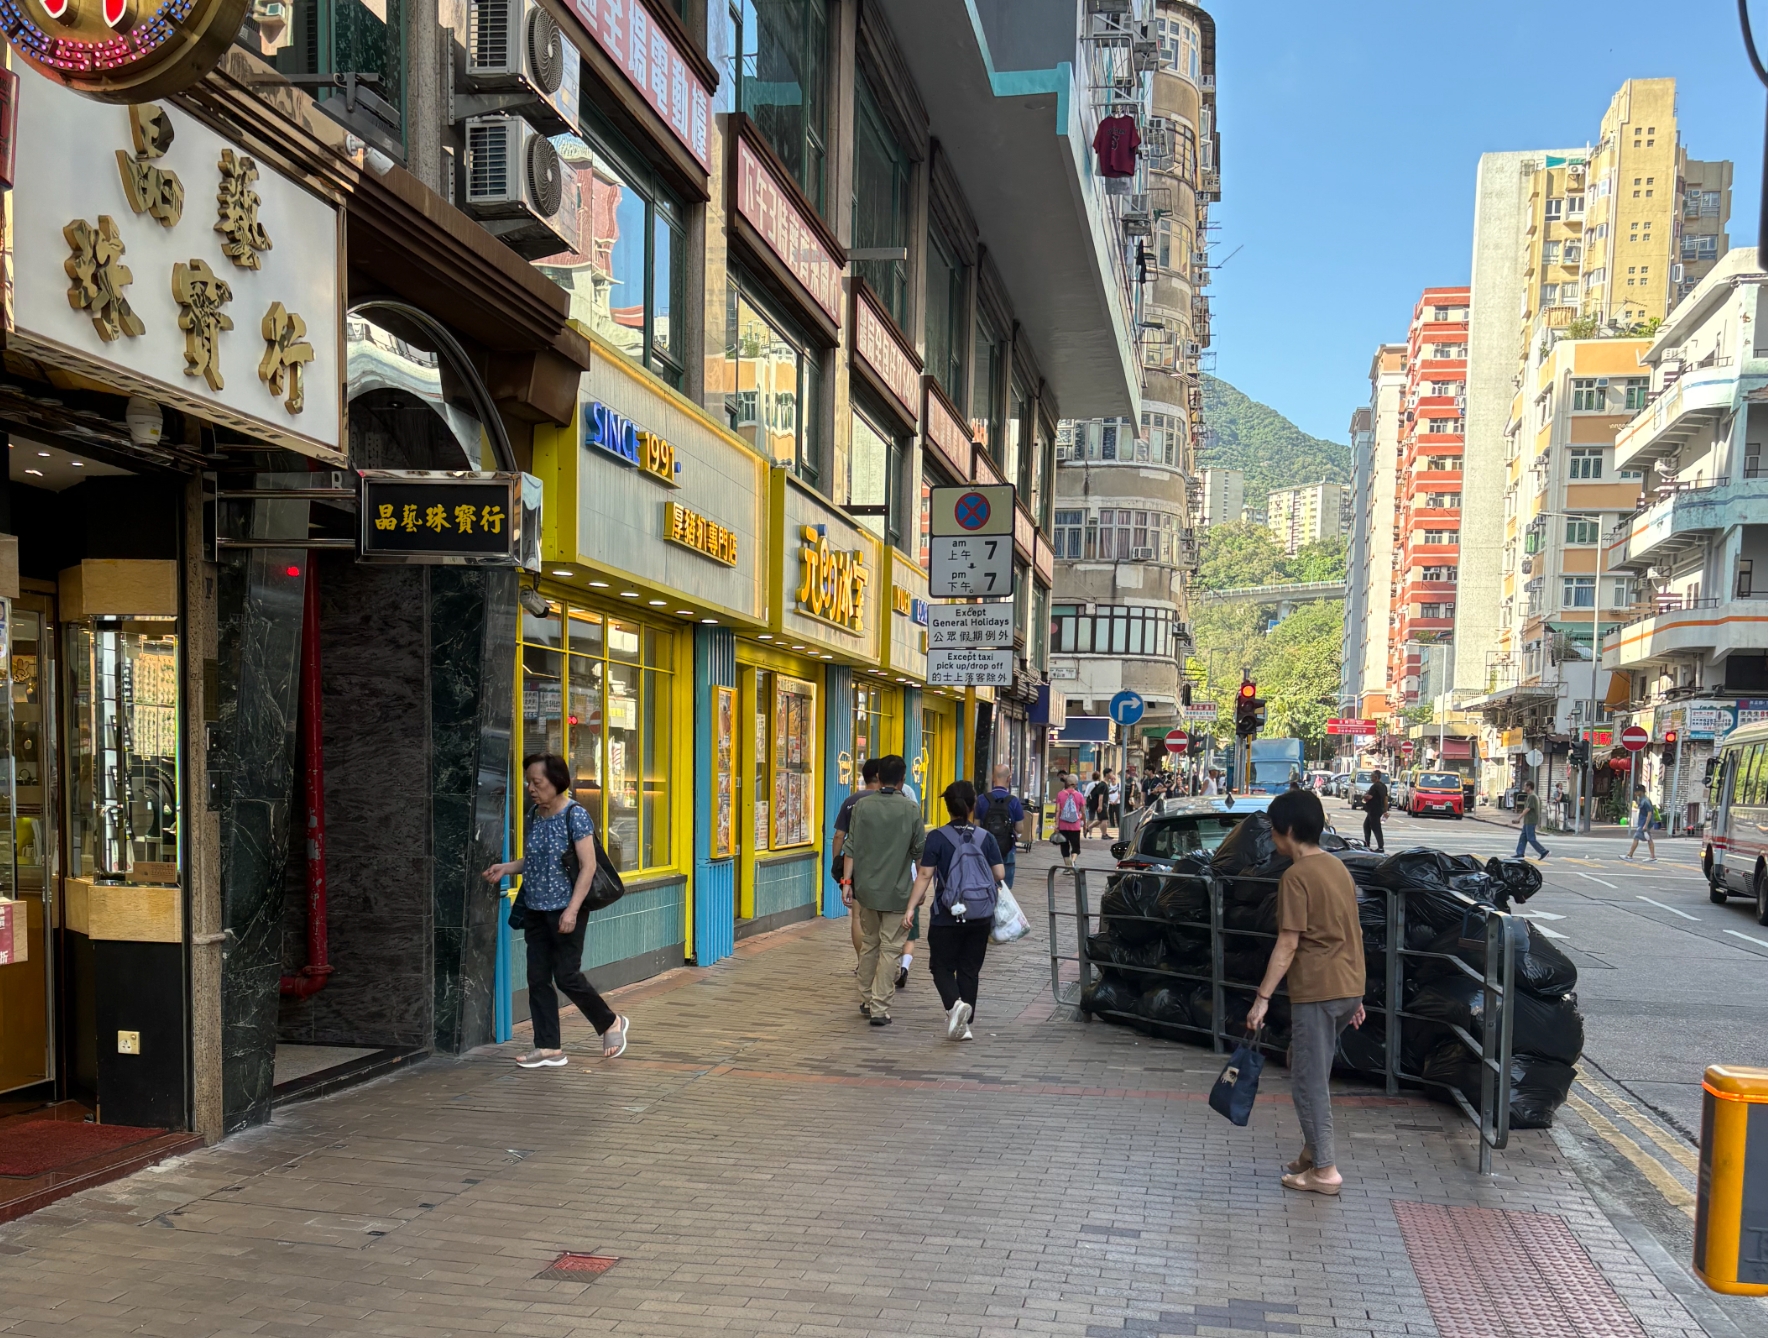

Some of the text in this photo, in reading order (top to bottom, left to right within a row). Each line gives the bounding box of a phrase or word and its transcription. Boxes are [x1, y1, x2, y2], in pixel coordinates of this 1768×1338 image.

[592, 401, 675, 482] SINCE 1991
[672, 502, 738, 567] 厚豬扒專門店
[952, 540, 967, 548] am
[947, 549, 972, 561] 上午
[984, 540, 998, 560] 7
[951, 572, 967, 580] pm
[947, 581, 971, 592] 下午
[983, 572, 997, 592] 7
[955, 608, 987, 617] Except
[932, 617, 1010, 627] General Holidays
[933, 629, 1009, 642] 公眾假期例外
[947, 652, 994, 661] Except taxi
[936, 662, 1003, 671] pick up/drop off
[931, 672, 1007, 683] 的士上落客除外
